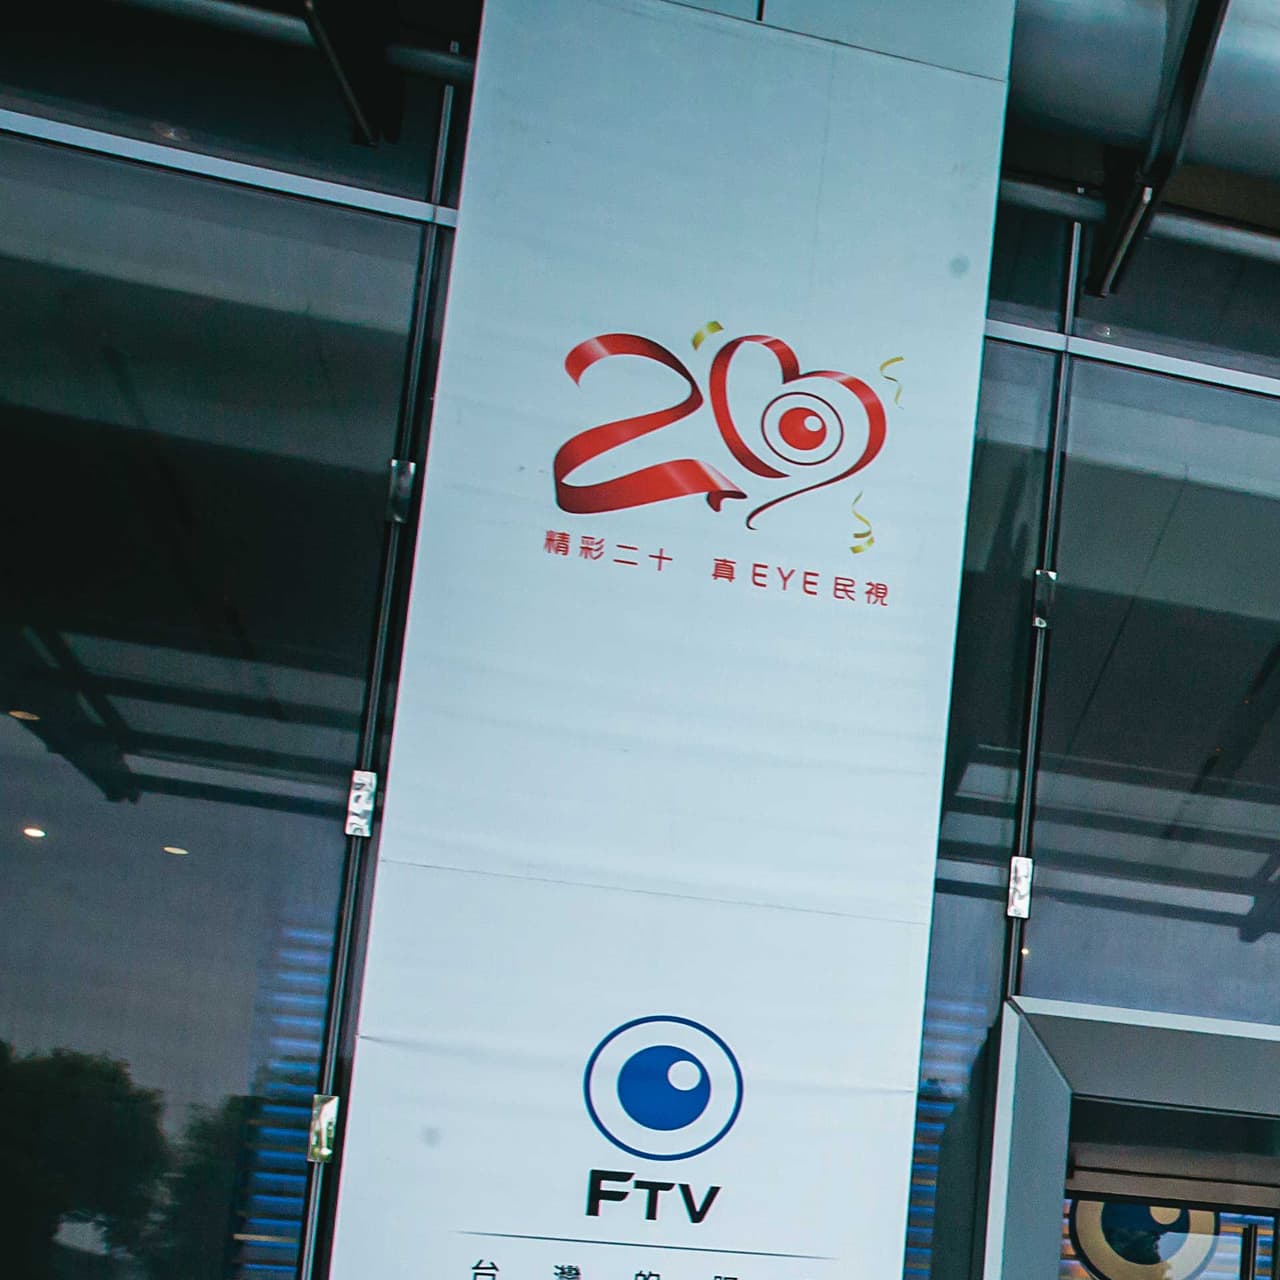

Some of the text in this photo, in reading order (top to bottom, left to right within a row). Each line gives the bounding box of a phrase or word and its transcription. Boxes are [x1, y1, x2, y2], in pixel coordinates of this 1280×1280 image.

[543, 529, 890, 607] 精彩二十 真EYE民視
[584, 1168, 722, 1225] FTV
